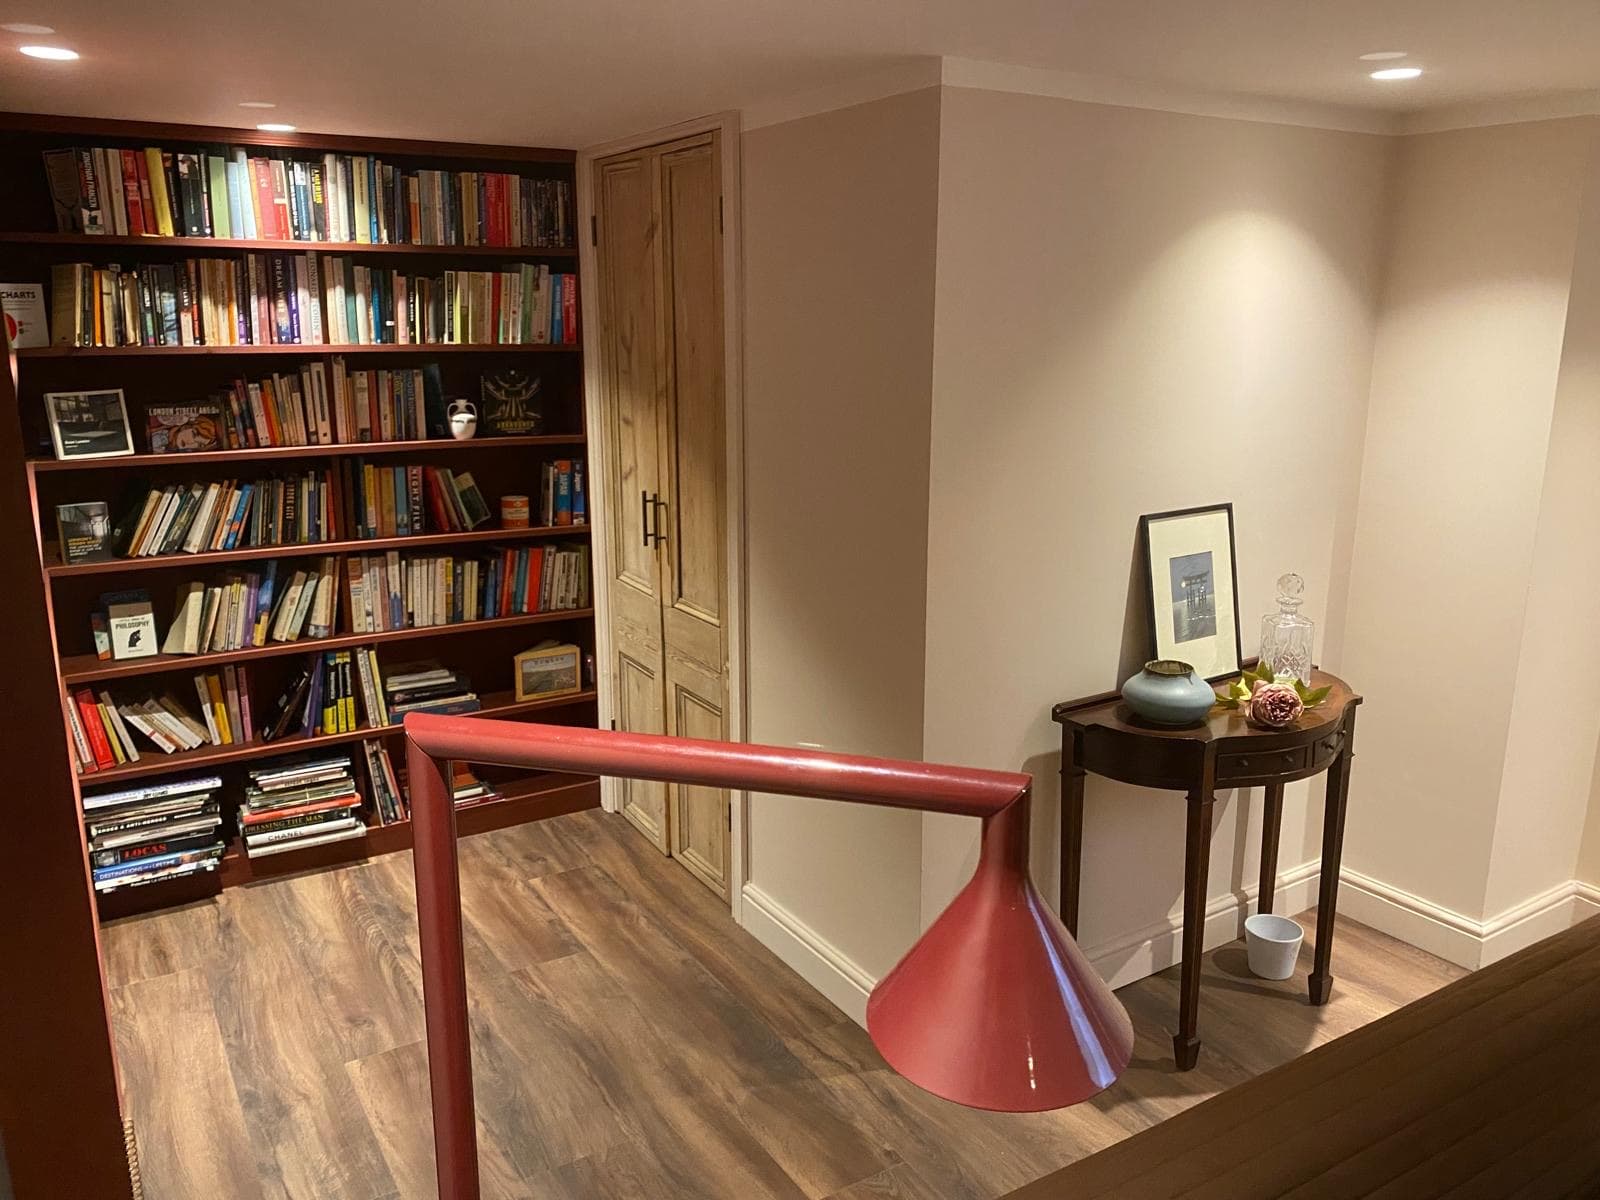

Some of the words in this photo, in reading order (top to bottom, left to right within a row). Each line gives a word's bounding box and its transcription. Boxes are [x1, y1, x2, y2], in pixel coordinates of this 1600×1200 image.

[410, 468, 419, 503] NIGHT
[412, 505, 421, 531] FILM
[305, 814, 324, 823] MAN
[267, 831, 304, 841] CHANEL
[99, 866, 143, 880] DESTINATIONS
